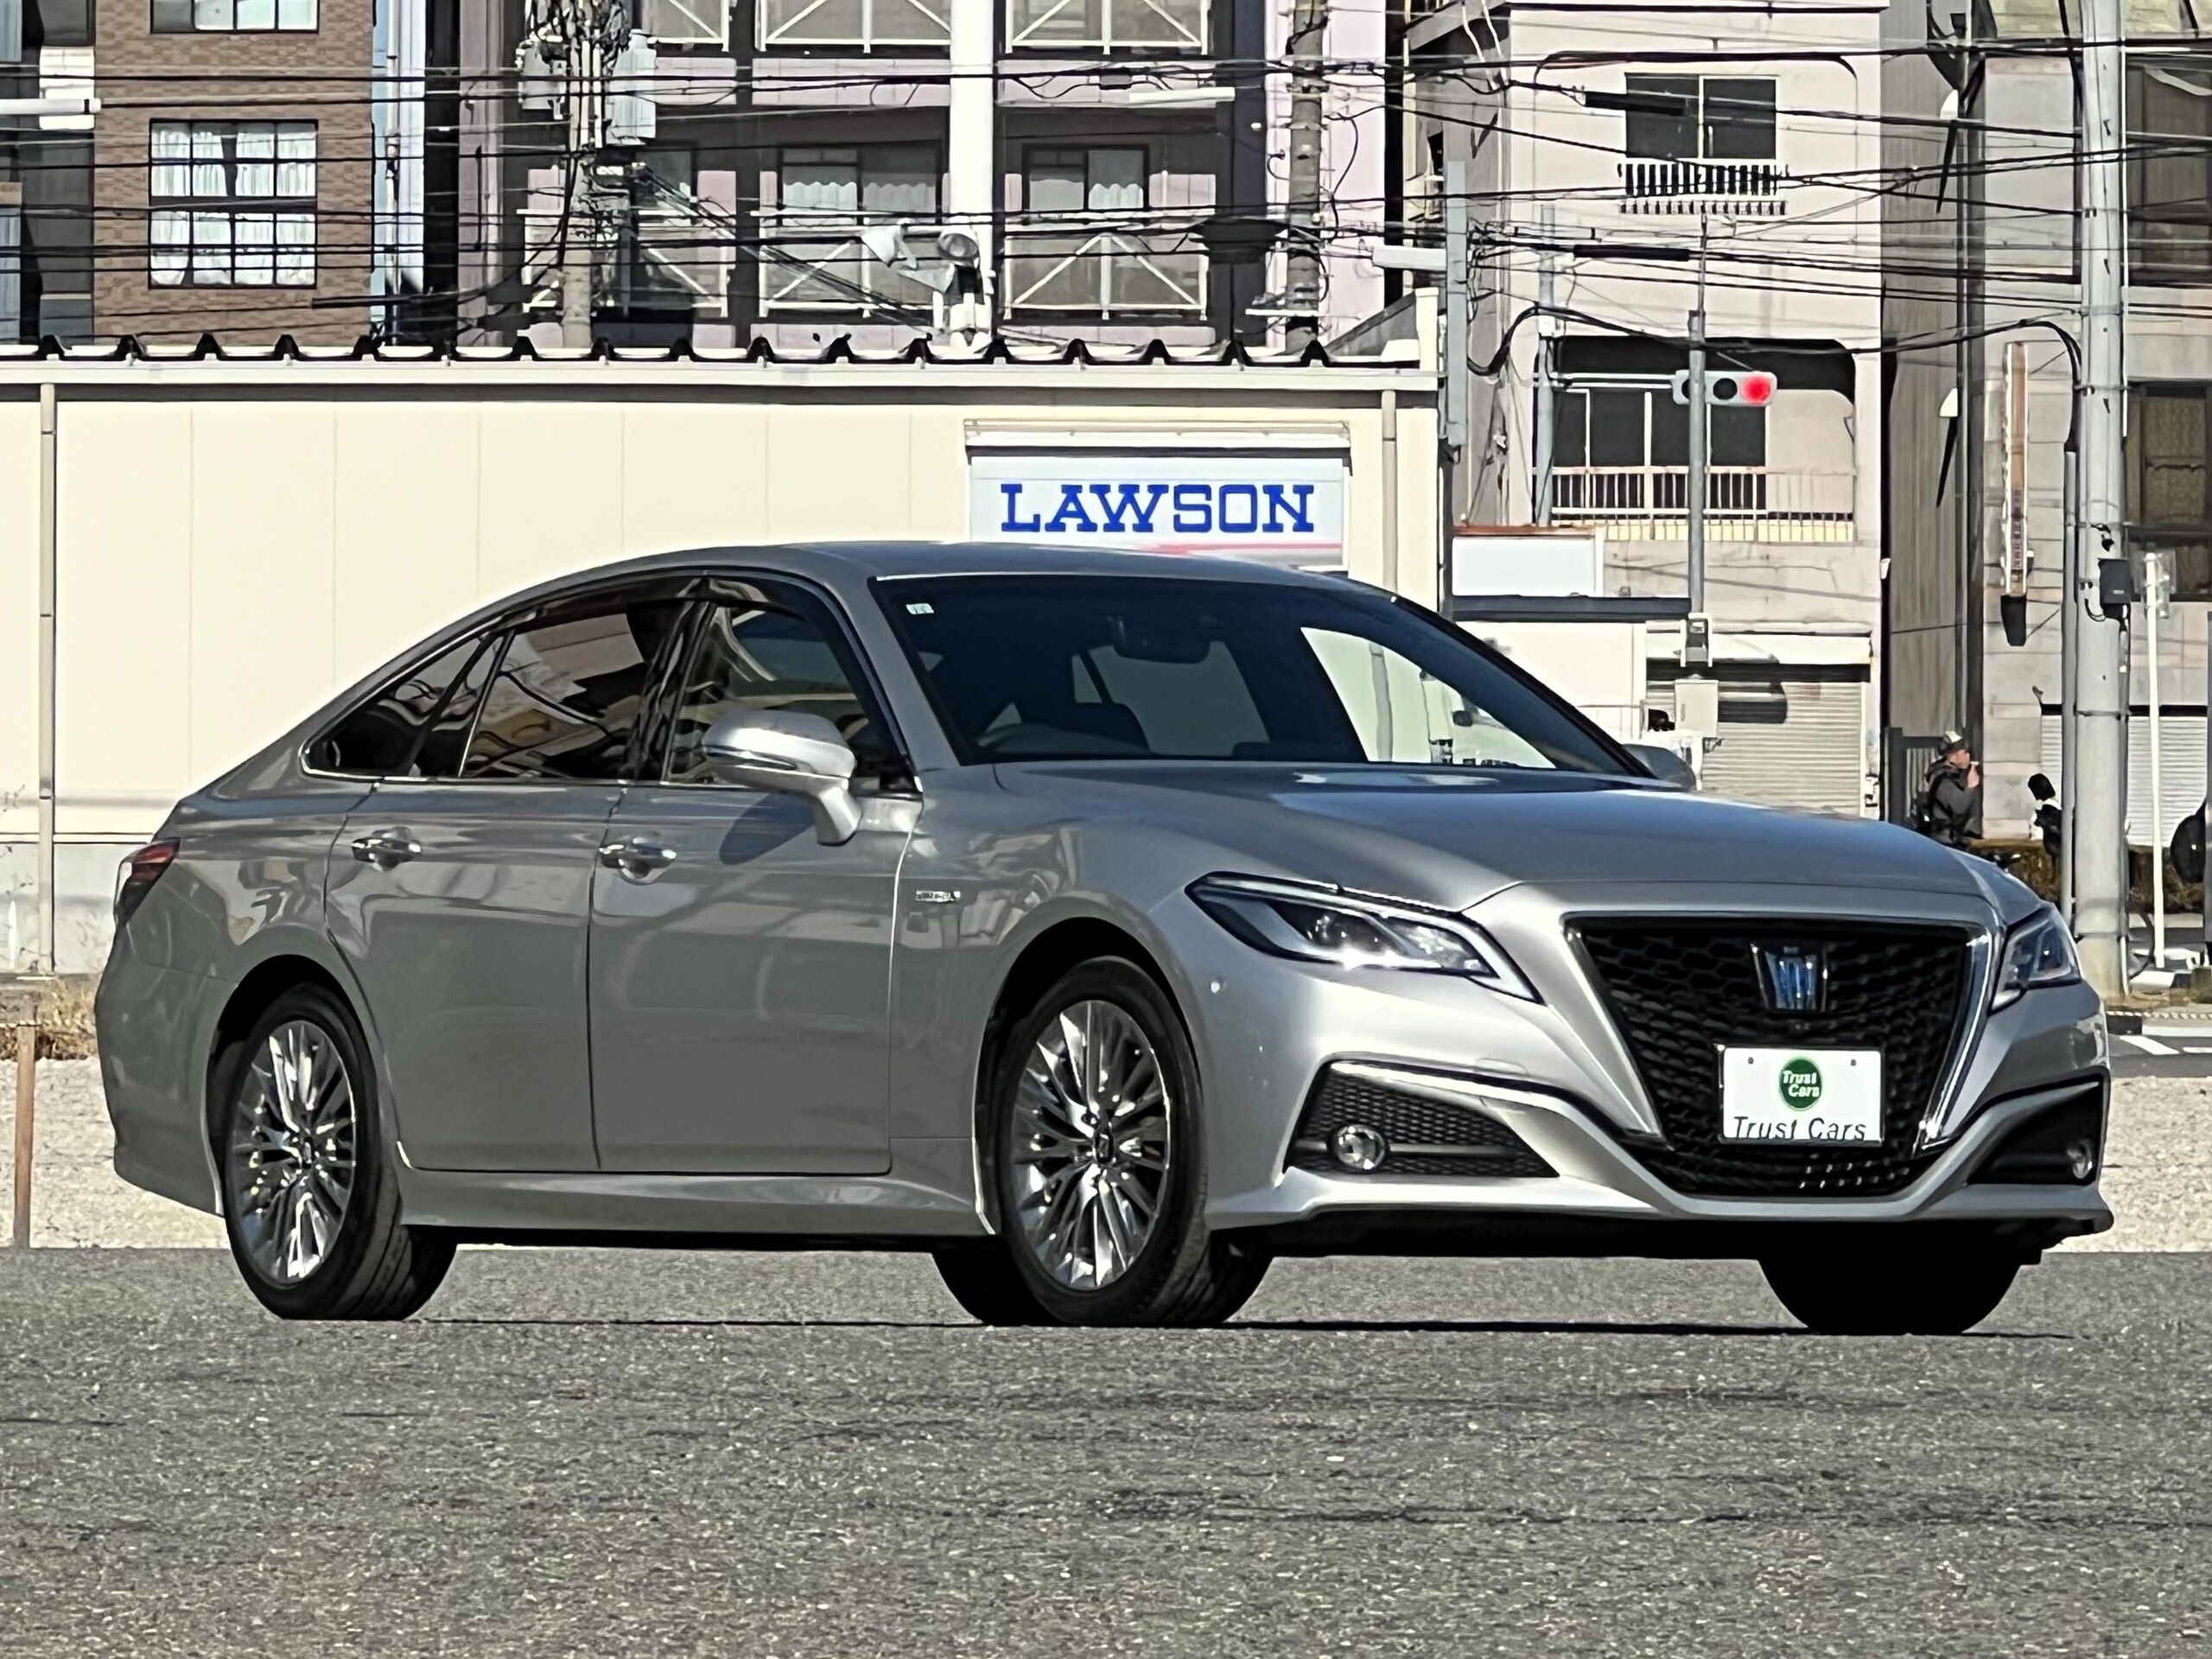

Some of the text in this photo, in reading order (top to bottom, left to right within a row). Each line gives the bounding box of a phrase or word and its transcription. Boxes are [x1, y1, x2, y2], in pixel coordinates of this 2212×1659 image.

[1001, 483, 1314, 533] LAWSON
[1782, 1070, 1818, 1084] Trust
[1788, 1084, 1821, 1098] Cars
[1733, 1116, 1867, 1141] Trust Cars
